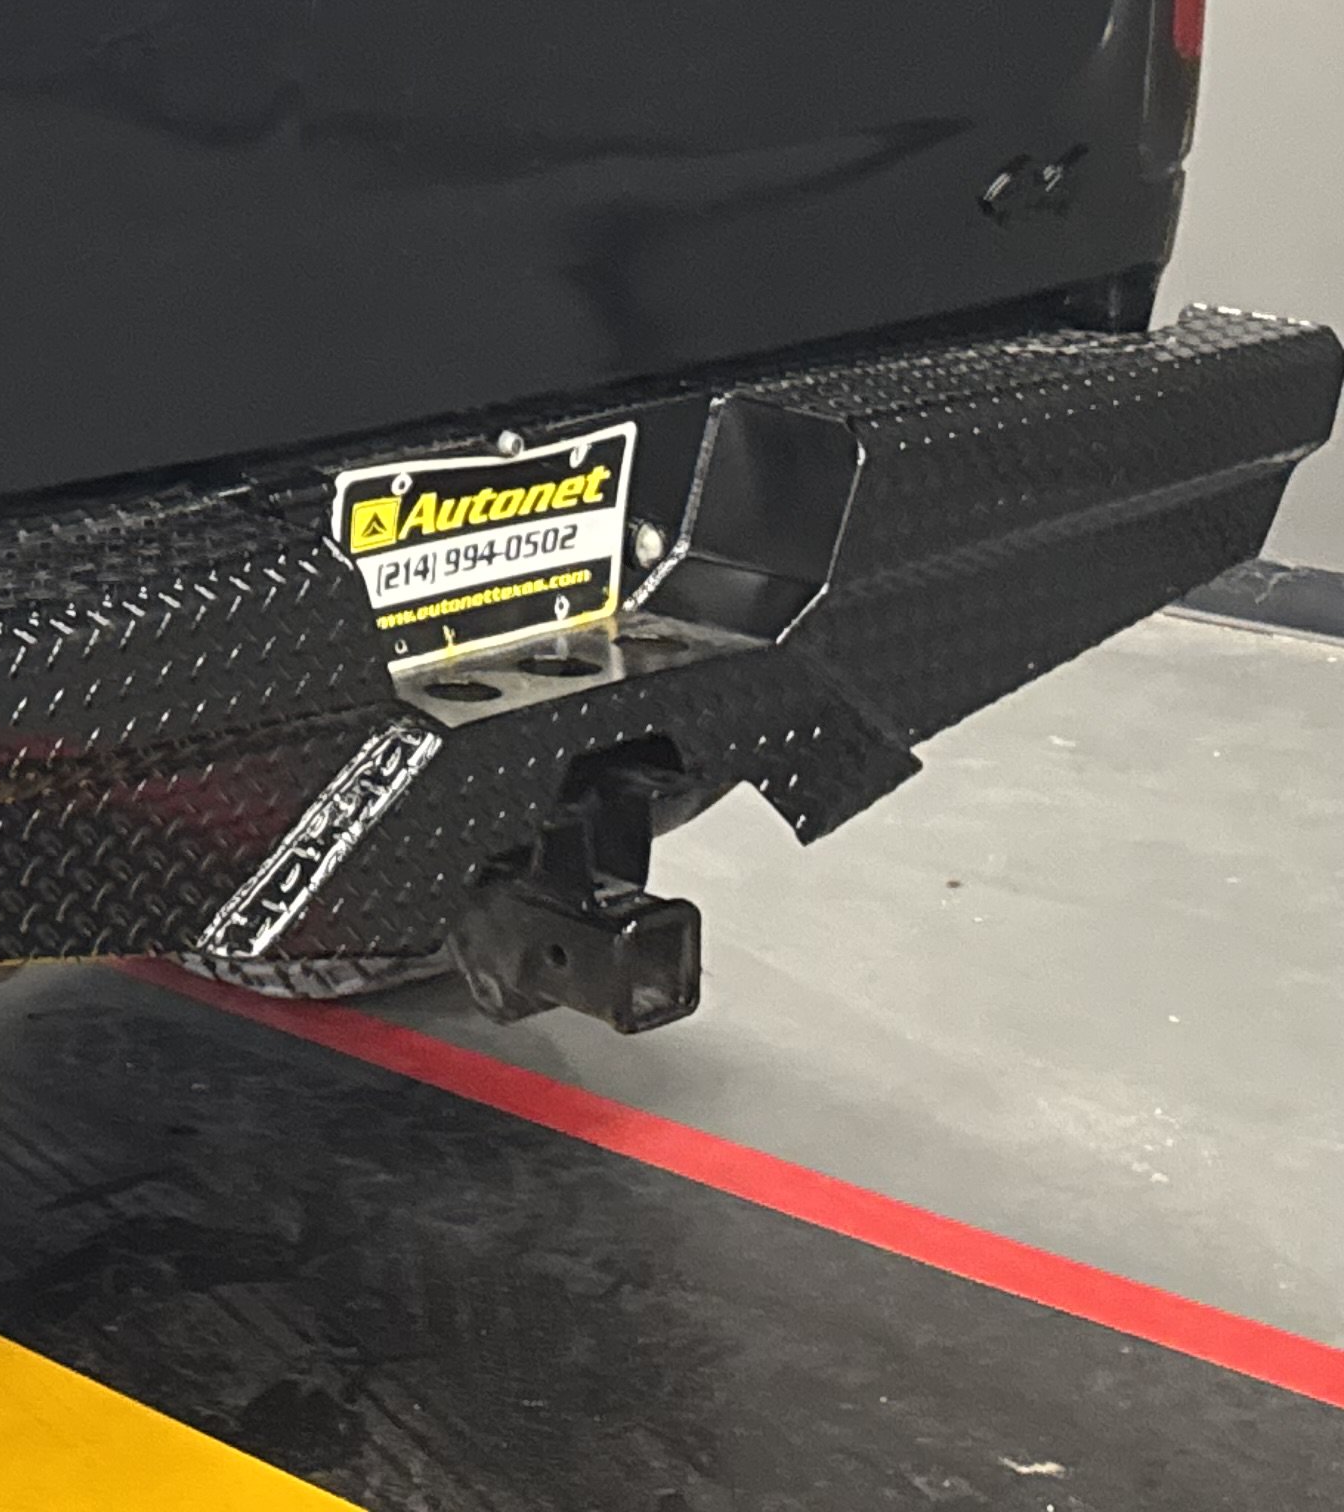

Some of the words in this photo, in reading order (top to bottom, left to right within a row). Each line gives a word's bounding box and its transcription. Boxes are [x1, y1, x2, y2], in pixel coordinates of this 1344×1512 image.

[398, 464, 612, 540] Autonet
[376, 551, 437, 596] (214)
[444, 523, 579, 577] 994-0502
